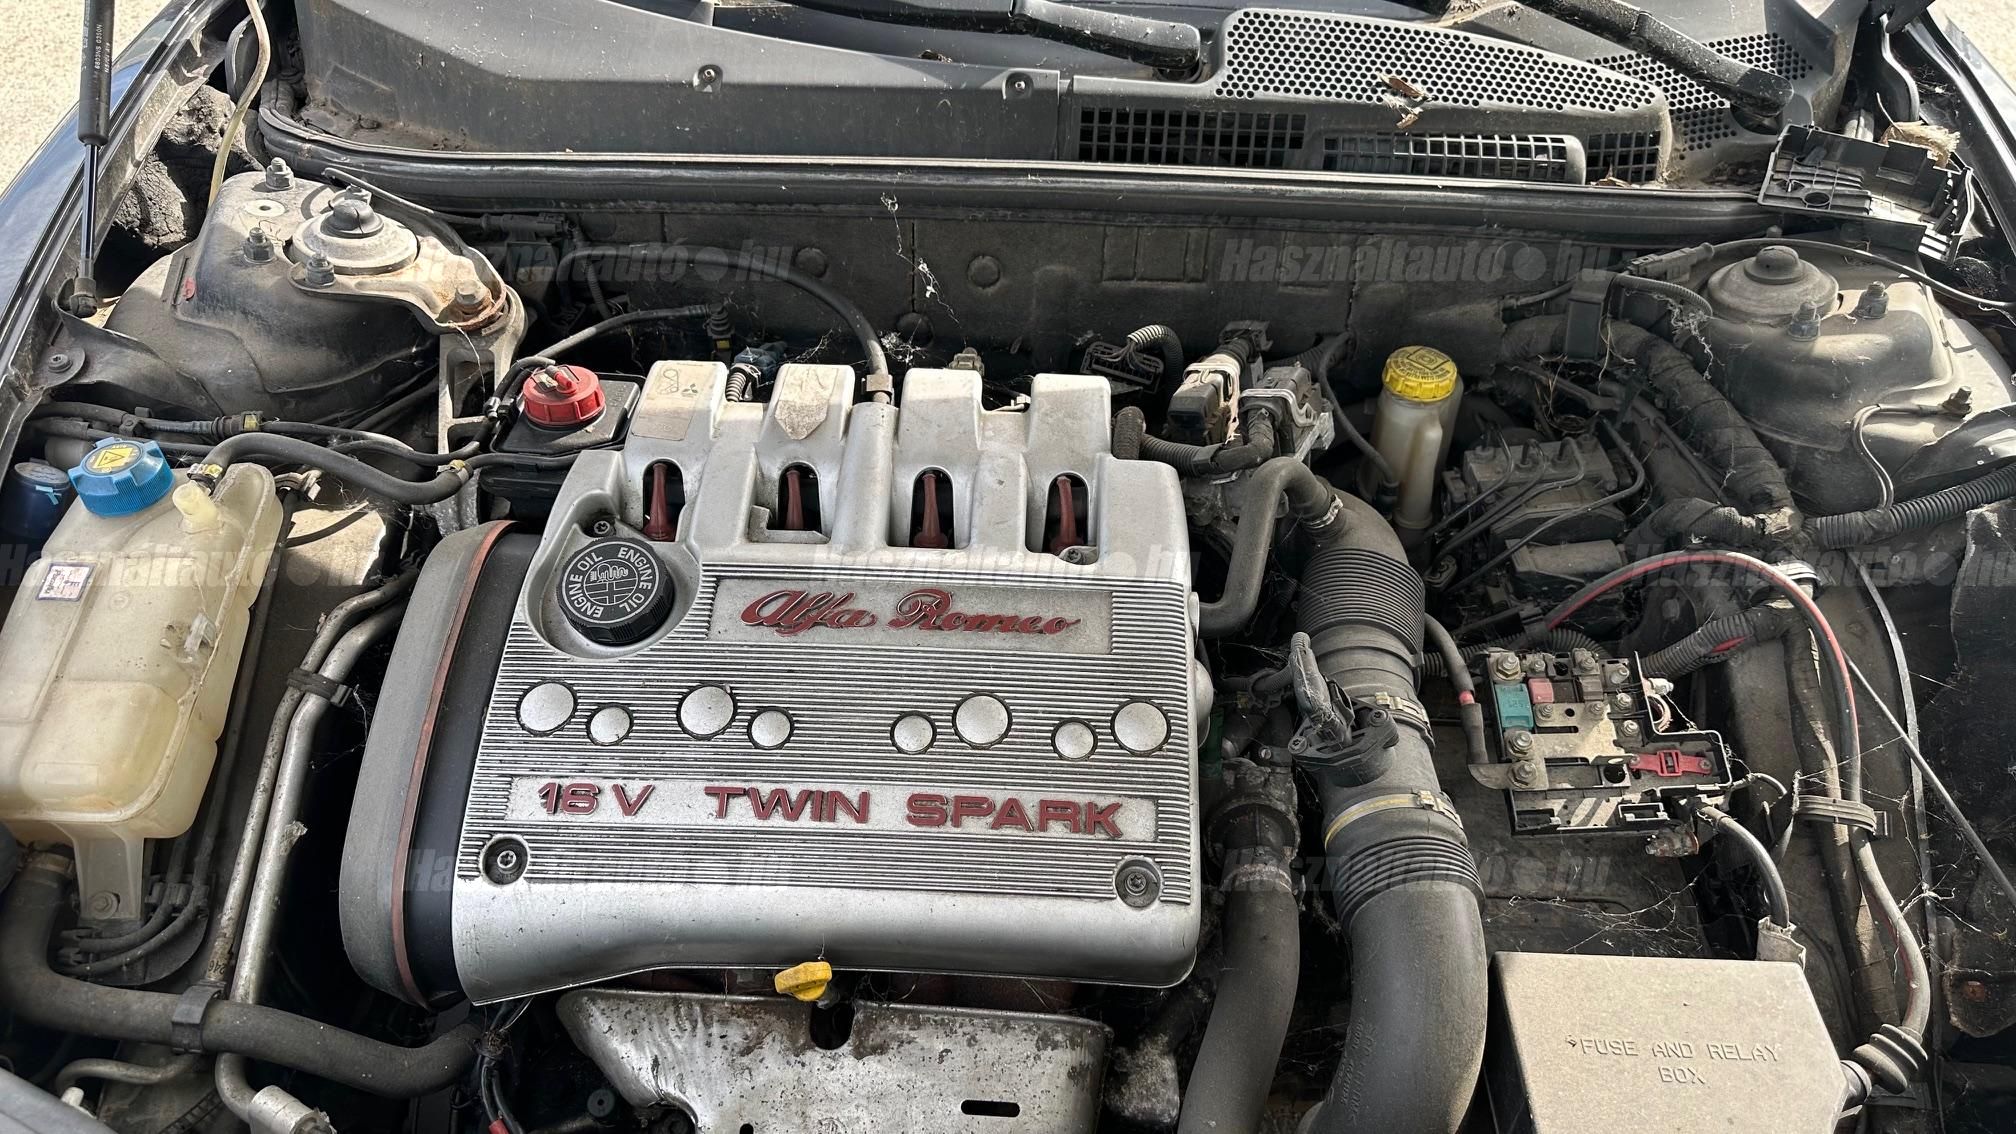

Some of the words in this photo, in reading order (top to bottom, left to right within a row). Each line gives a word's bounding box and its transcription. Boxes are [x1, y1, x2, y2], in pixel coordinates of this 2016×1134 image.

[577, 552, 603, 571] OIL
[617, 547, 653, 589] ENGINE
[568, 574, 604, 618] ENGINE
[619, 592, 645, 612] OIL
[740, 589, 877, 637] Alfa
[886, 588, 1082, 635] Romeo
[704, 786, 871, 824] TWIN
[907, 793, 1122, 838] SPARK
[1580, 1038, 1638, 1056] FUSE
[1652, 1041, 1693, 1059] AND
[1706, 1043, 1778, 1062] RELAY
[1658, 1066, 1705, 1085] BOX
